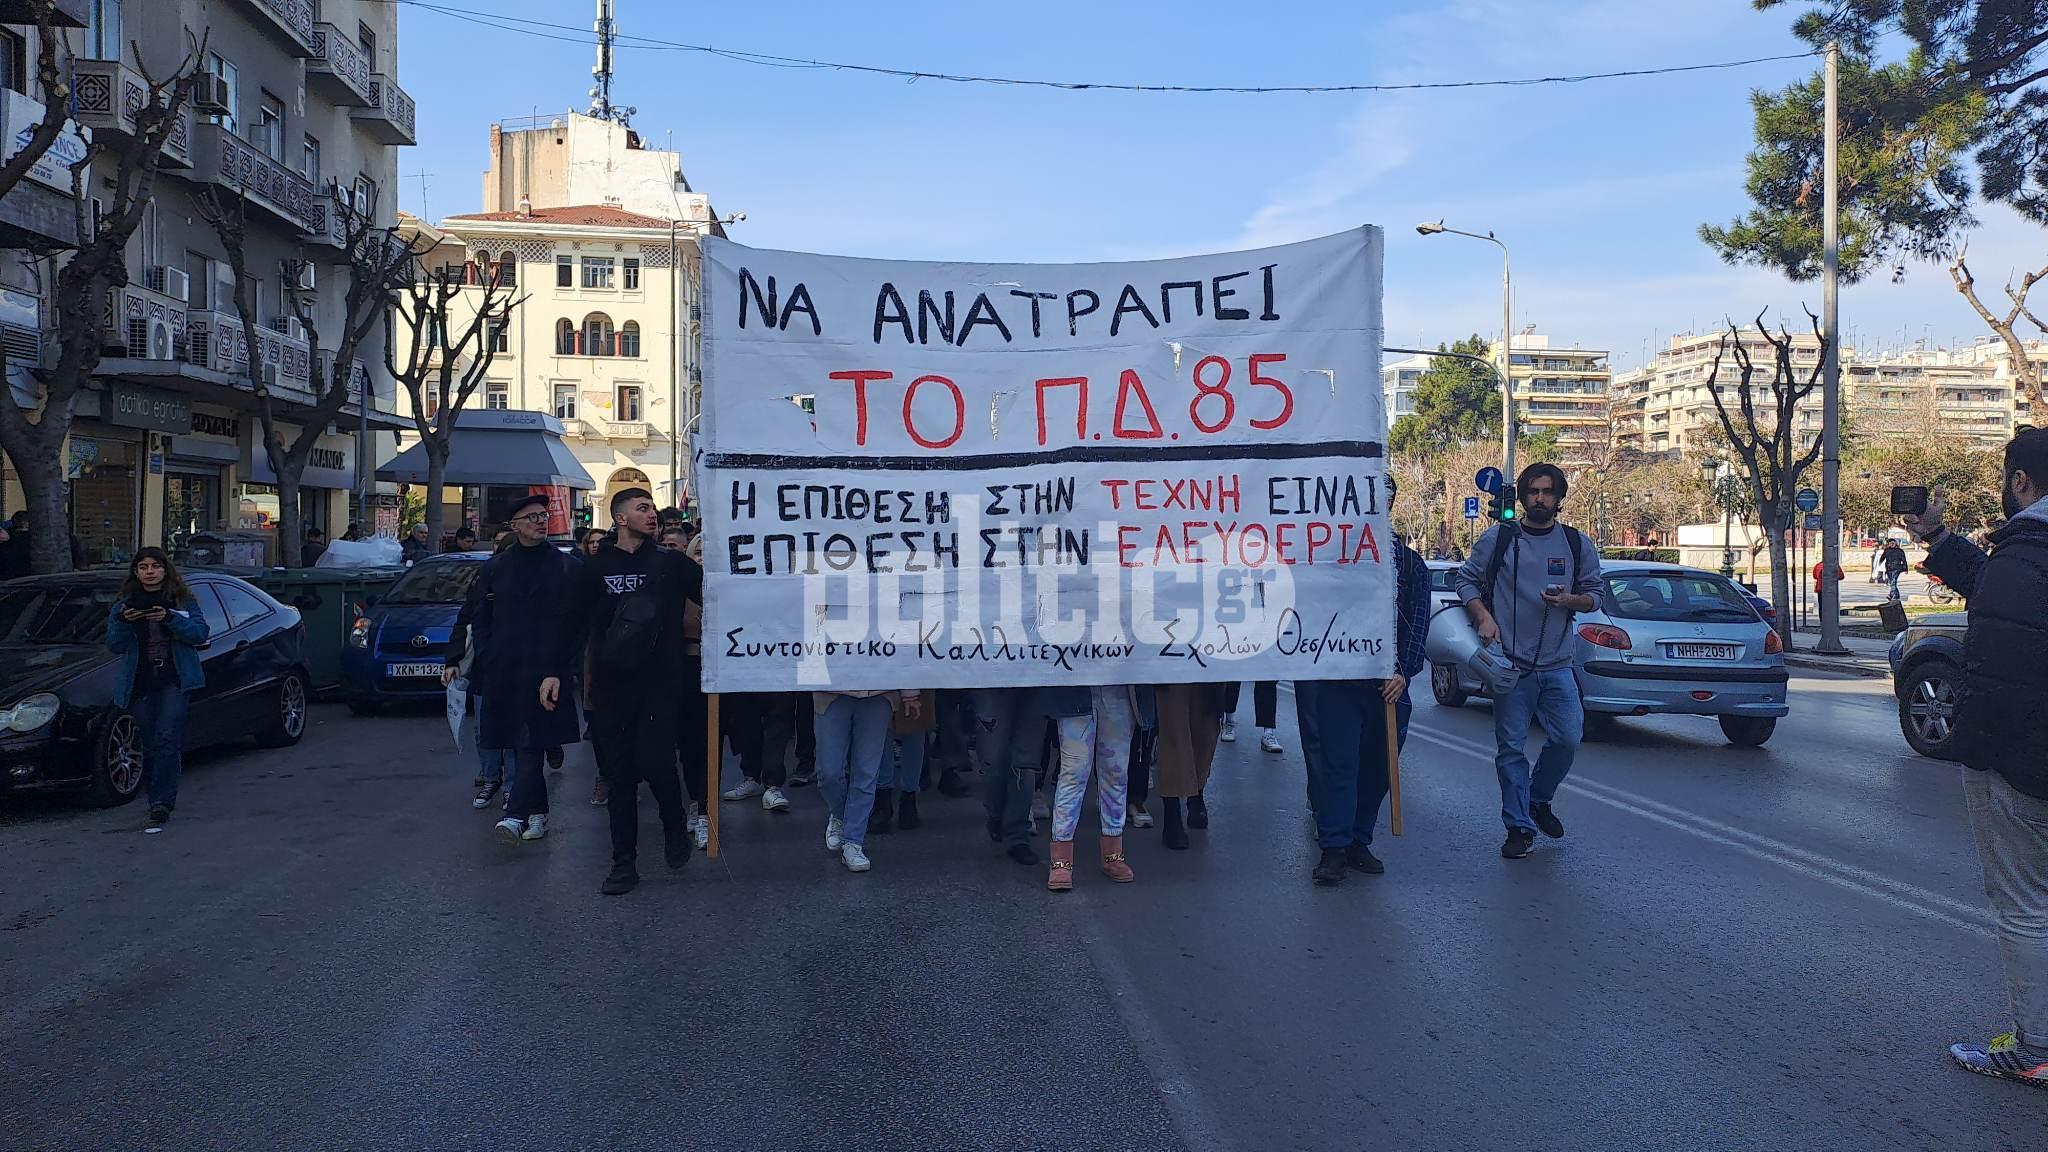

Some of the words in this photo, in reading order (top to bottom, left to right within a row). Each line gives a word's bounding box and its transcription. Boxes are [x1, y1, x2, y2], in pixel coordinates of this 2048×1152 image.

[738, 266, 822, 336] ΝΑ
[873, 263, 1280, 347] ΑΝΑΤΡΑΠΕΙ
[829, 370, 965, 449] ΤΟ
[1035, 353, 1294, 446] Π.Δ.85
[308, 447, 346, 471] ΜΑΝΟΣ
[731, 481, 756, 520] Η
[777, 484, 950, 524] ΕΠΙΘΕΣΗ
[985, 476, 1075, 515] ΣΤΗΝ
[1100, 474, 1241, 513] ΤΕΧΝΗ
[1268, 474, 1380, 516] ΕΙΝΑΙ
[729, 531, 959, 575] ΕΠΙΘΕΣΗ
[979, 527, 1089, 568] ΣΤΗΝ
[1117, 520, 1380, 568] ΕΛΕΥΘΕΡΙΑ
[726, 626, 896, 658] Συντονιστικό
[918, 620, 1134, 671] Καλλιτεχνικών
[1159, 618, 1261, 668] Σχολών
[1277, 607, 1383, 664] Θεσ/νίκης
